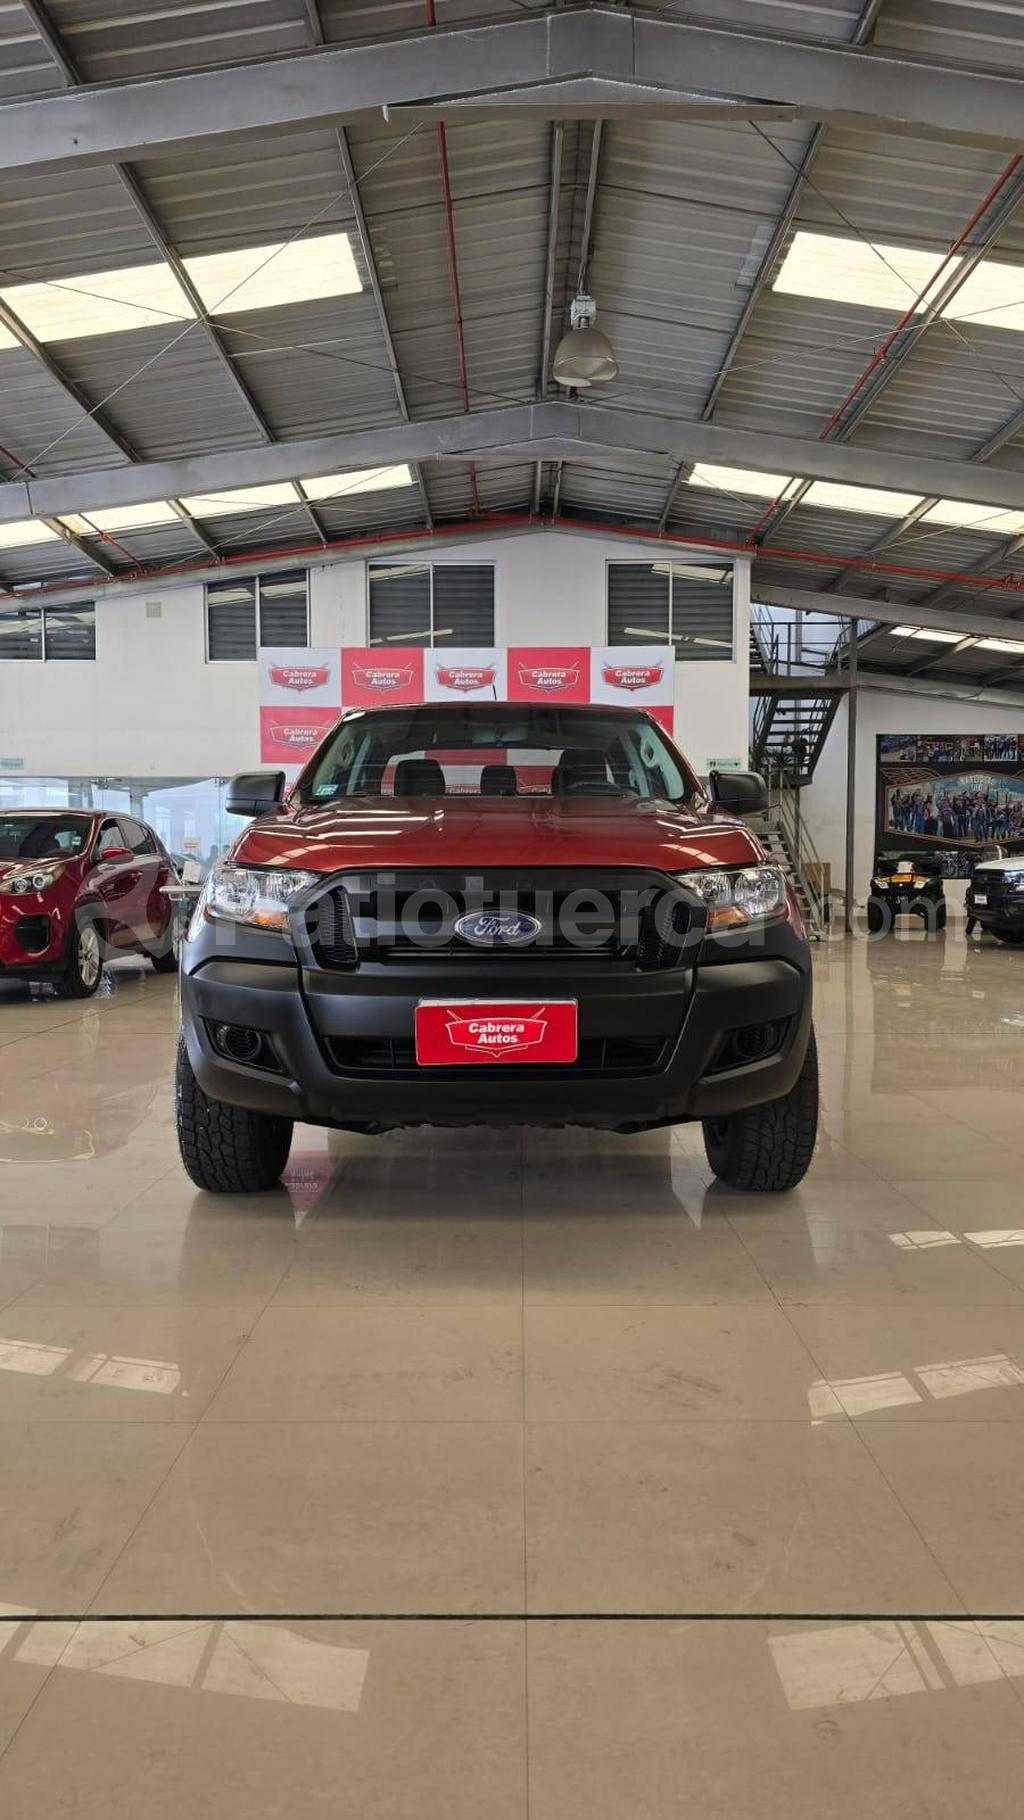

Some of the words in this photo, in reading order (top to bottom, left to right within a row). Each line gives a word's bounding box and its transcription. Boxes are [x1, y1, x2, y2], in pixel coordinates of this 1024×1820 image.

[283, 670, 317, 678] Cabrera
[365, 670, 400, 678] Cabrera
[449, 670, 483, 678] Cabrera
[531, 670, 566, 678] Cabrera
[615, 670, 650, 678] Cabrera
[288, 677, 314, 685] Autos
[371, 677, 397, 685] Autos
[454, 677, 479, 685] Autos
[537, 677, 562, 685] Autos
[620, 677, 646, 685] Autos
[283, 728, 318, 736] Cabrera
[473, 915, 521, 936] Ford
[468, 1023, 525, 1034] Cabrera
[477, 1033, 519, 1044] Autos
